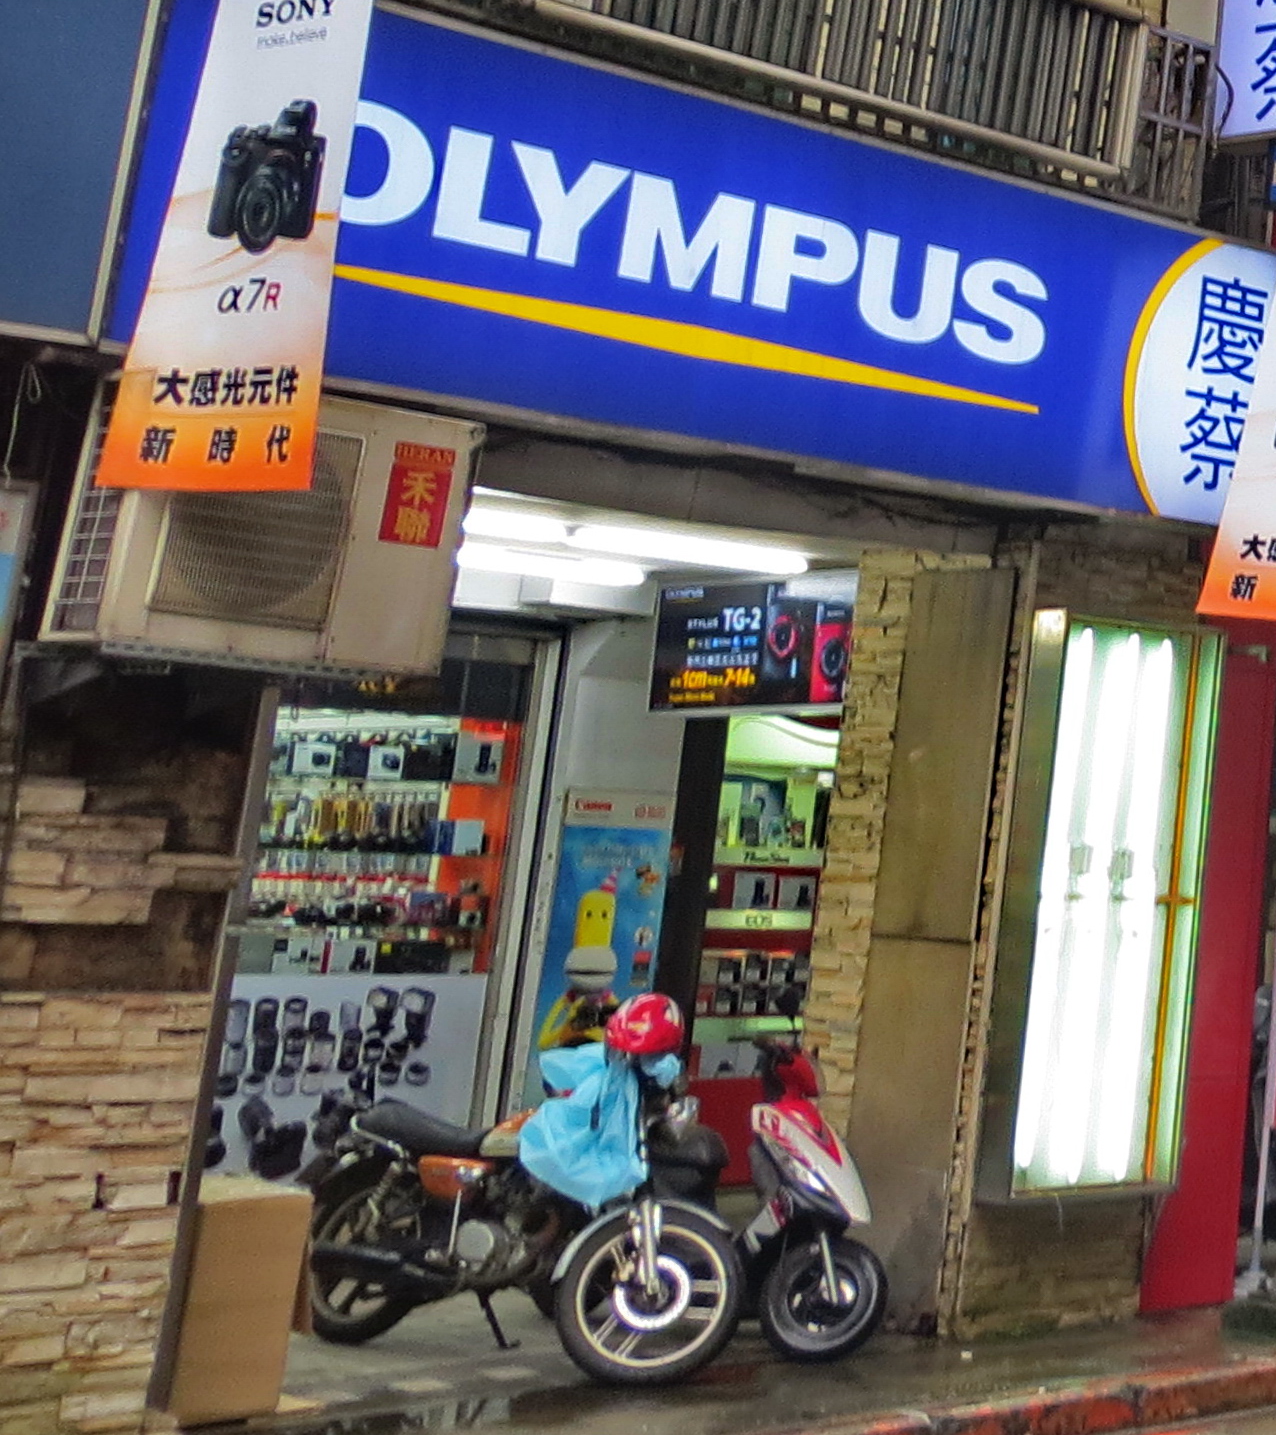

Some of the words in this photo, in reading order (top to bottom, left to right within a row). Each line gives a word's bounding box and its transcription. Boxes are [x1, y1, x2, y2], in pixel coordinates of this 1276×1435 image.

[340, 97, 1049, 366] OLYMPUS
[153, 365, 299, 409] 大感光元件
[1180, 274, 1269, 492] 慶蔡
[722, 606, 763, 632] TG-2
